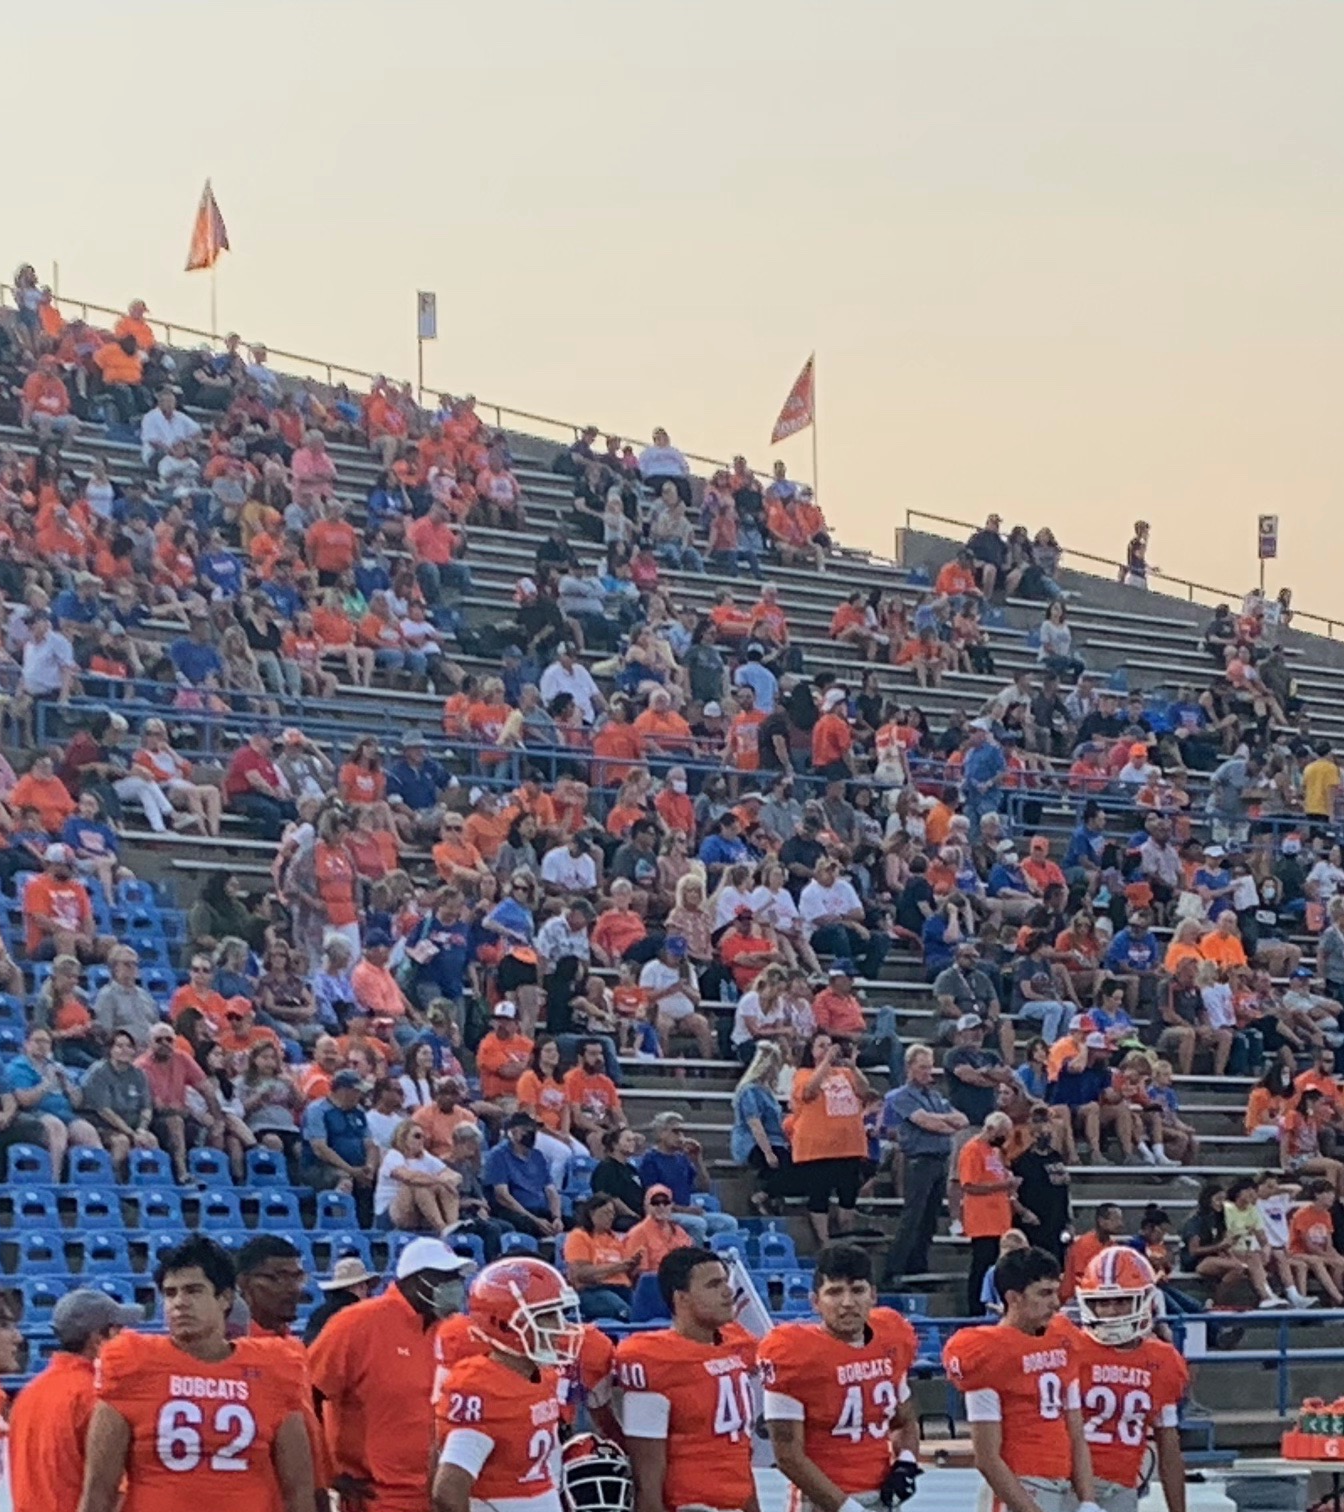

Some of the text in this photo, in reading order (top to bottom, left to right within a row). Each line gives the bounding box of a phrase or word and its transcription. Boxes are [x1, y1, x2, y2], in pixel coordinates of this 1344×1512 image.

[836, 1358, 893, 1385] BOBCATS
[1092, 1365, 1152, 1388] BOBCATS
[169, 1374, 249, 1400] BOBCATS
[448, 1392, 482, 1422] 28
[832, 1380, 898, 1444] 43
[1083, 1386, 1152, 1446] 26
[158, 1400, 256, 1472] 62
[1324, 1439, 1340, 1457] G
